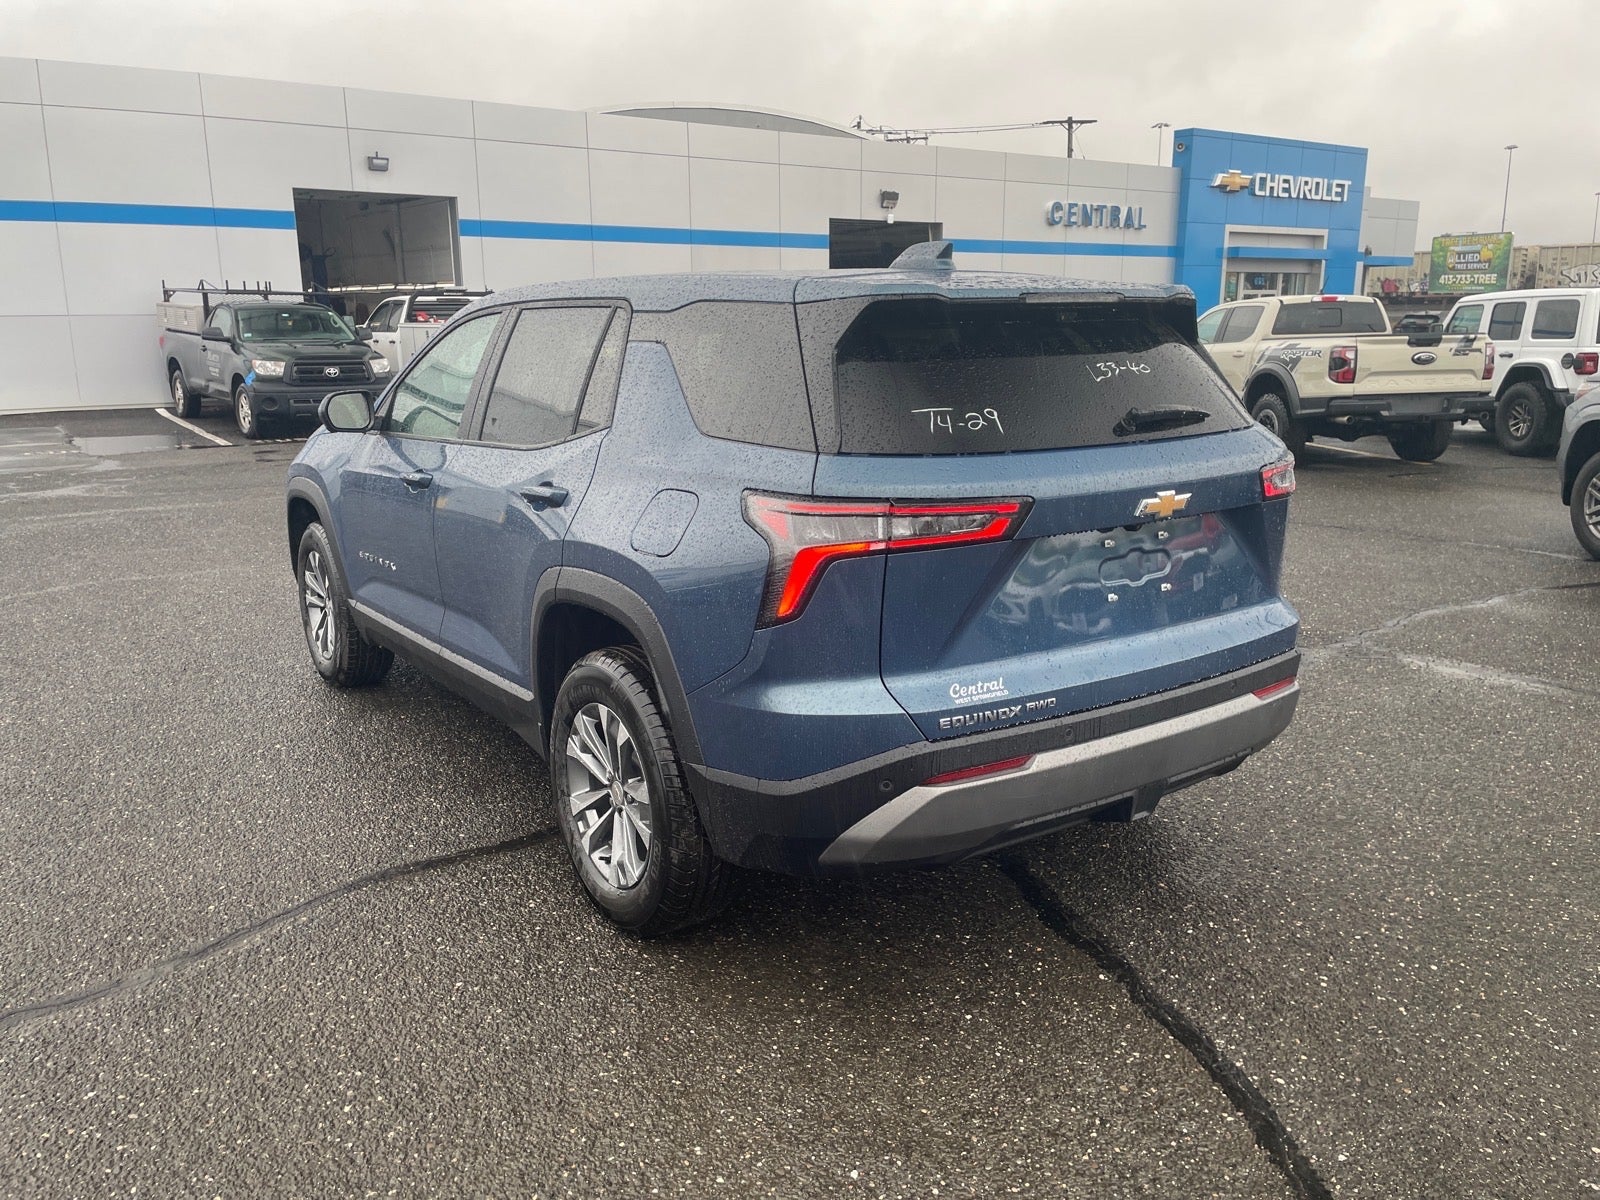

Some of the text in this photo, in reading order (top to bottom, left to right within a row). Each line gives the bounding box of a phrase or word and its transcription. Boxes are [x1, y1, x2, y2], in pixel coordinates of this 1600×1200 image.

[1254, 172, 1352, 202] CHEVROLET
[1047, 200, 1147, 230] CENTRAL
[1467, 262, 1489, 270] SERVICE
[1280, 349, 1322, 360] RAPTOR
[911, 407, 1004, 434] T4-29
[949, 676, 1005, 698] Central
[954, 689, 1009, 705] WEST SPRINGFIELD
[939, 705, 1022, 730] EQUINOX
